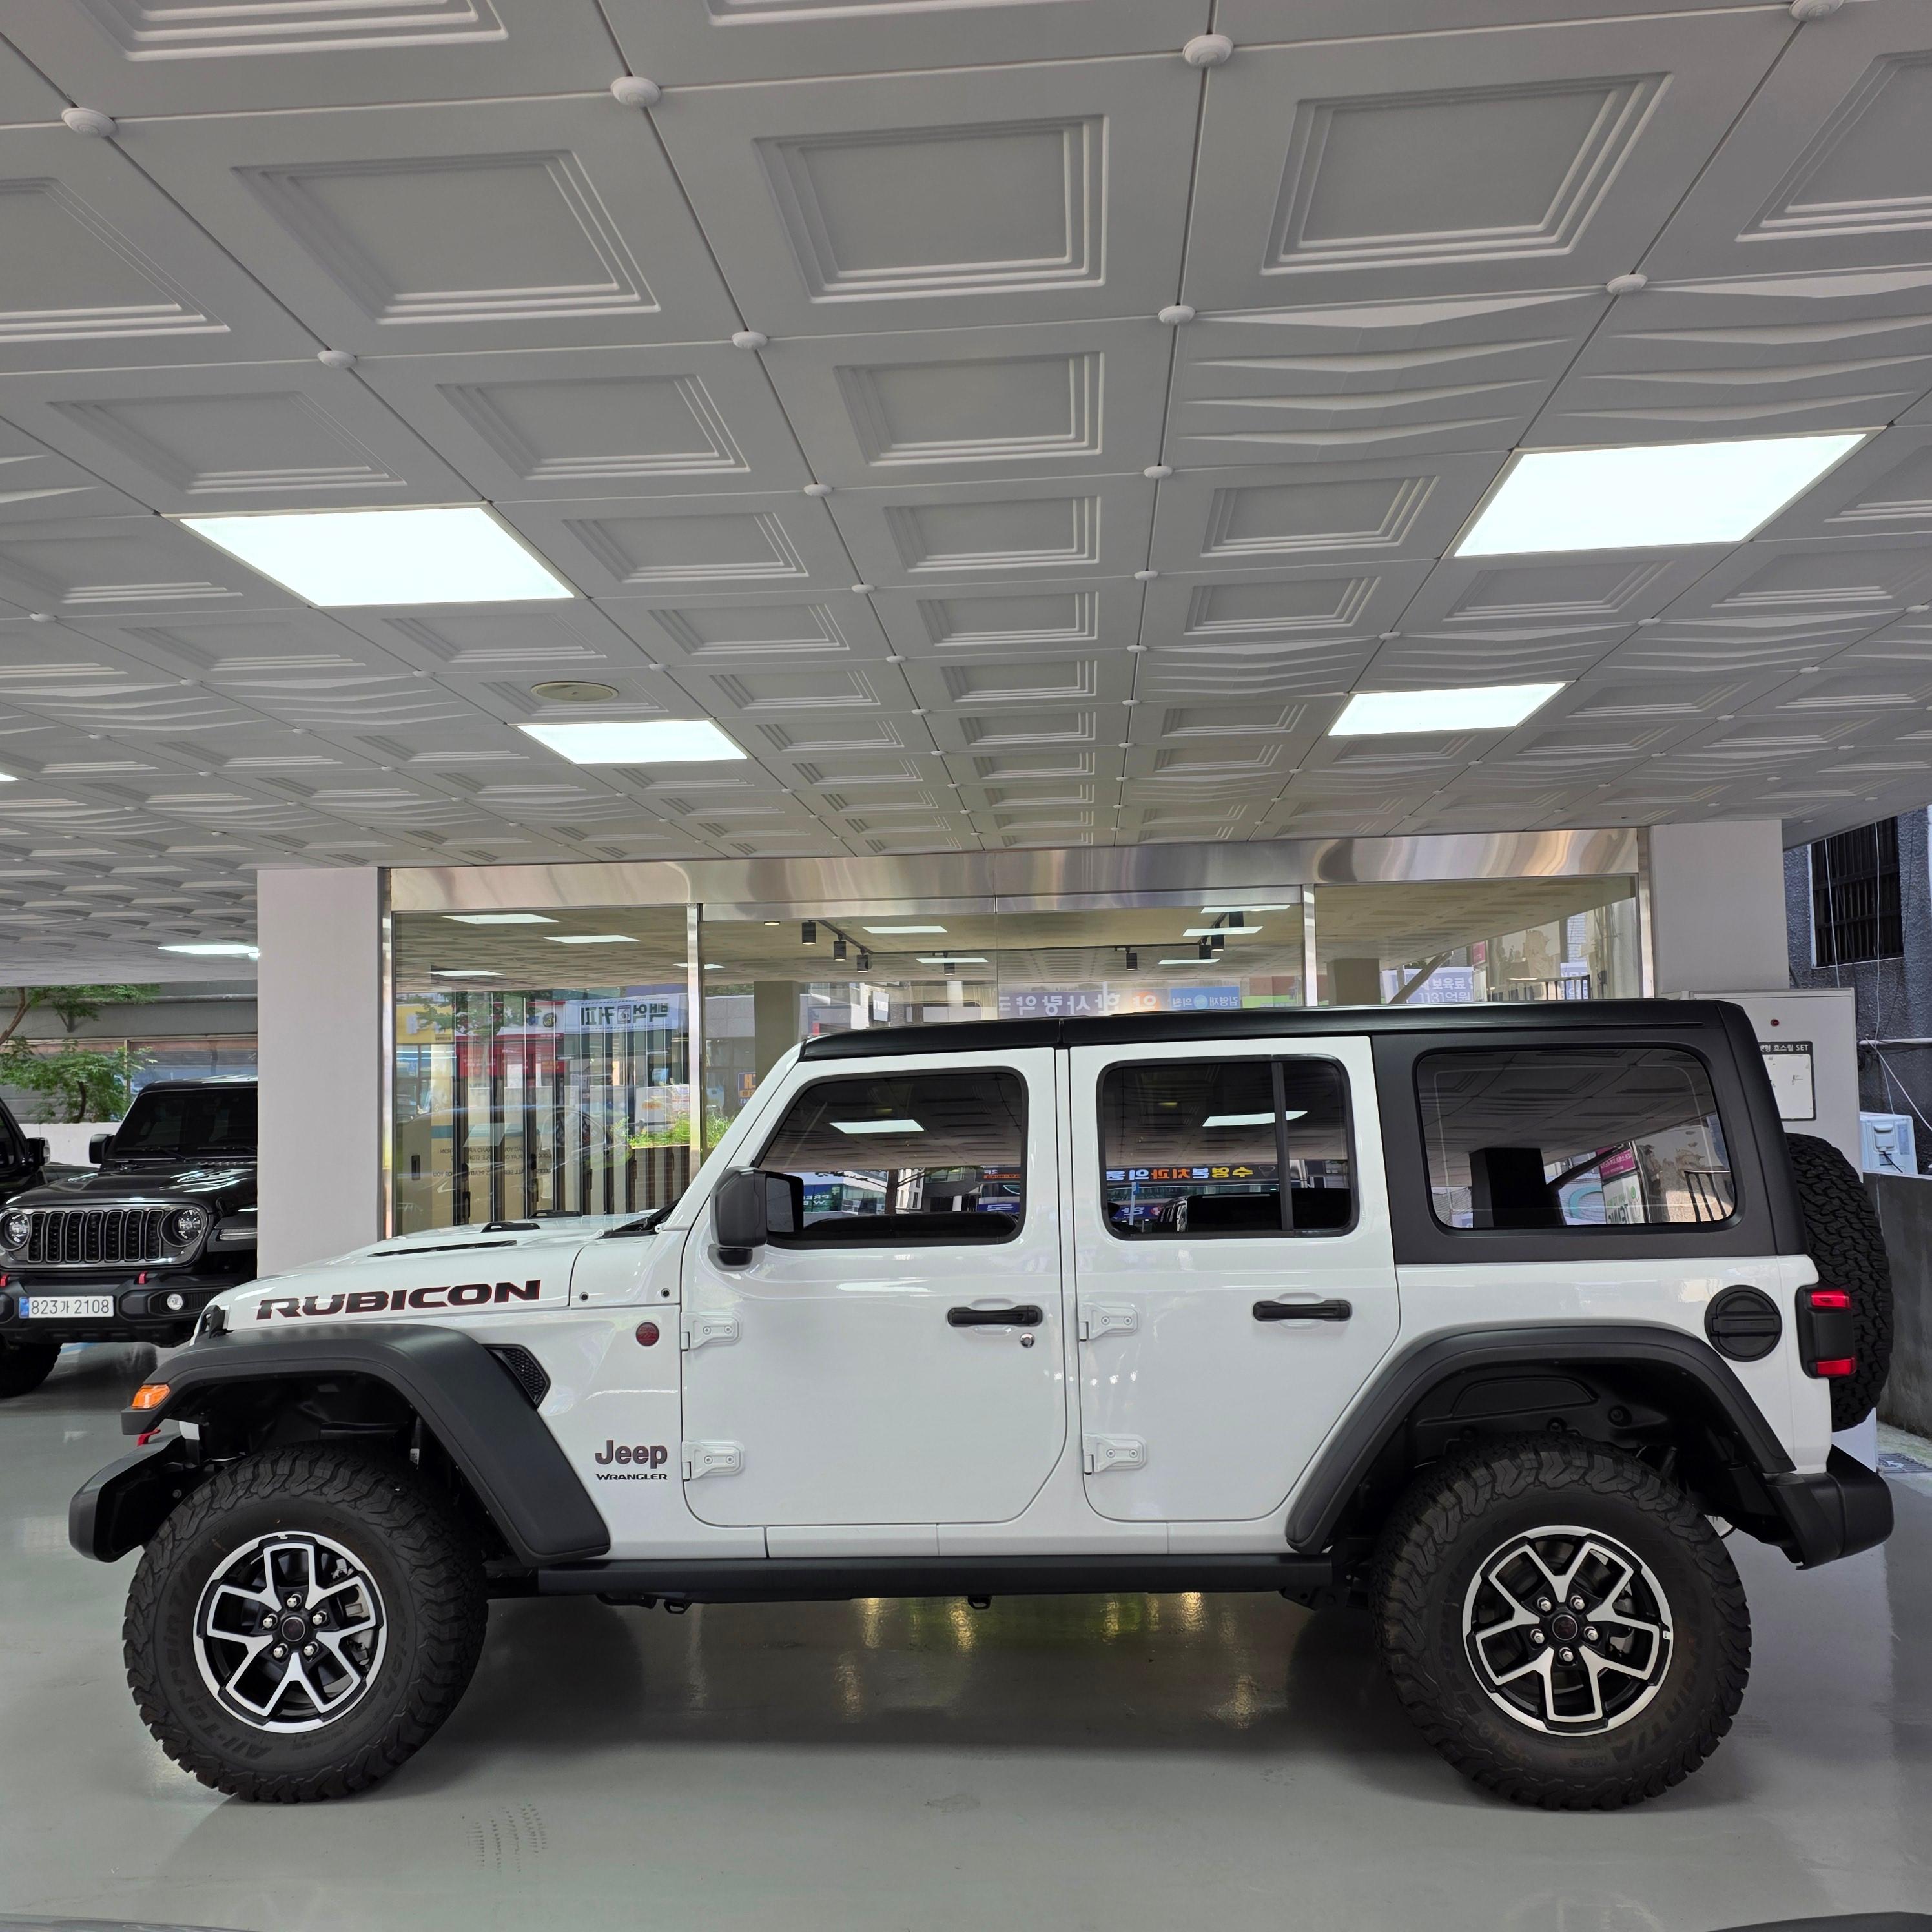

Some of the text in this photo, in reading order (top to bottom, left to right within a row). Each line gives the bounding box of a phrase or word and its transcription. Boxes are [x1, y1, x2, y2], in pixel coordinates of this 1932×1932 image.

[31, 1299, 109, 1315] 823가 2108
[256, 1279, 541, 1320] RUBICON
[595, 1440, 668, 1469] Jeep
